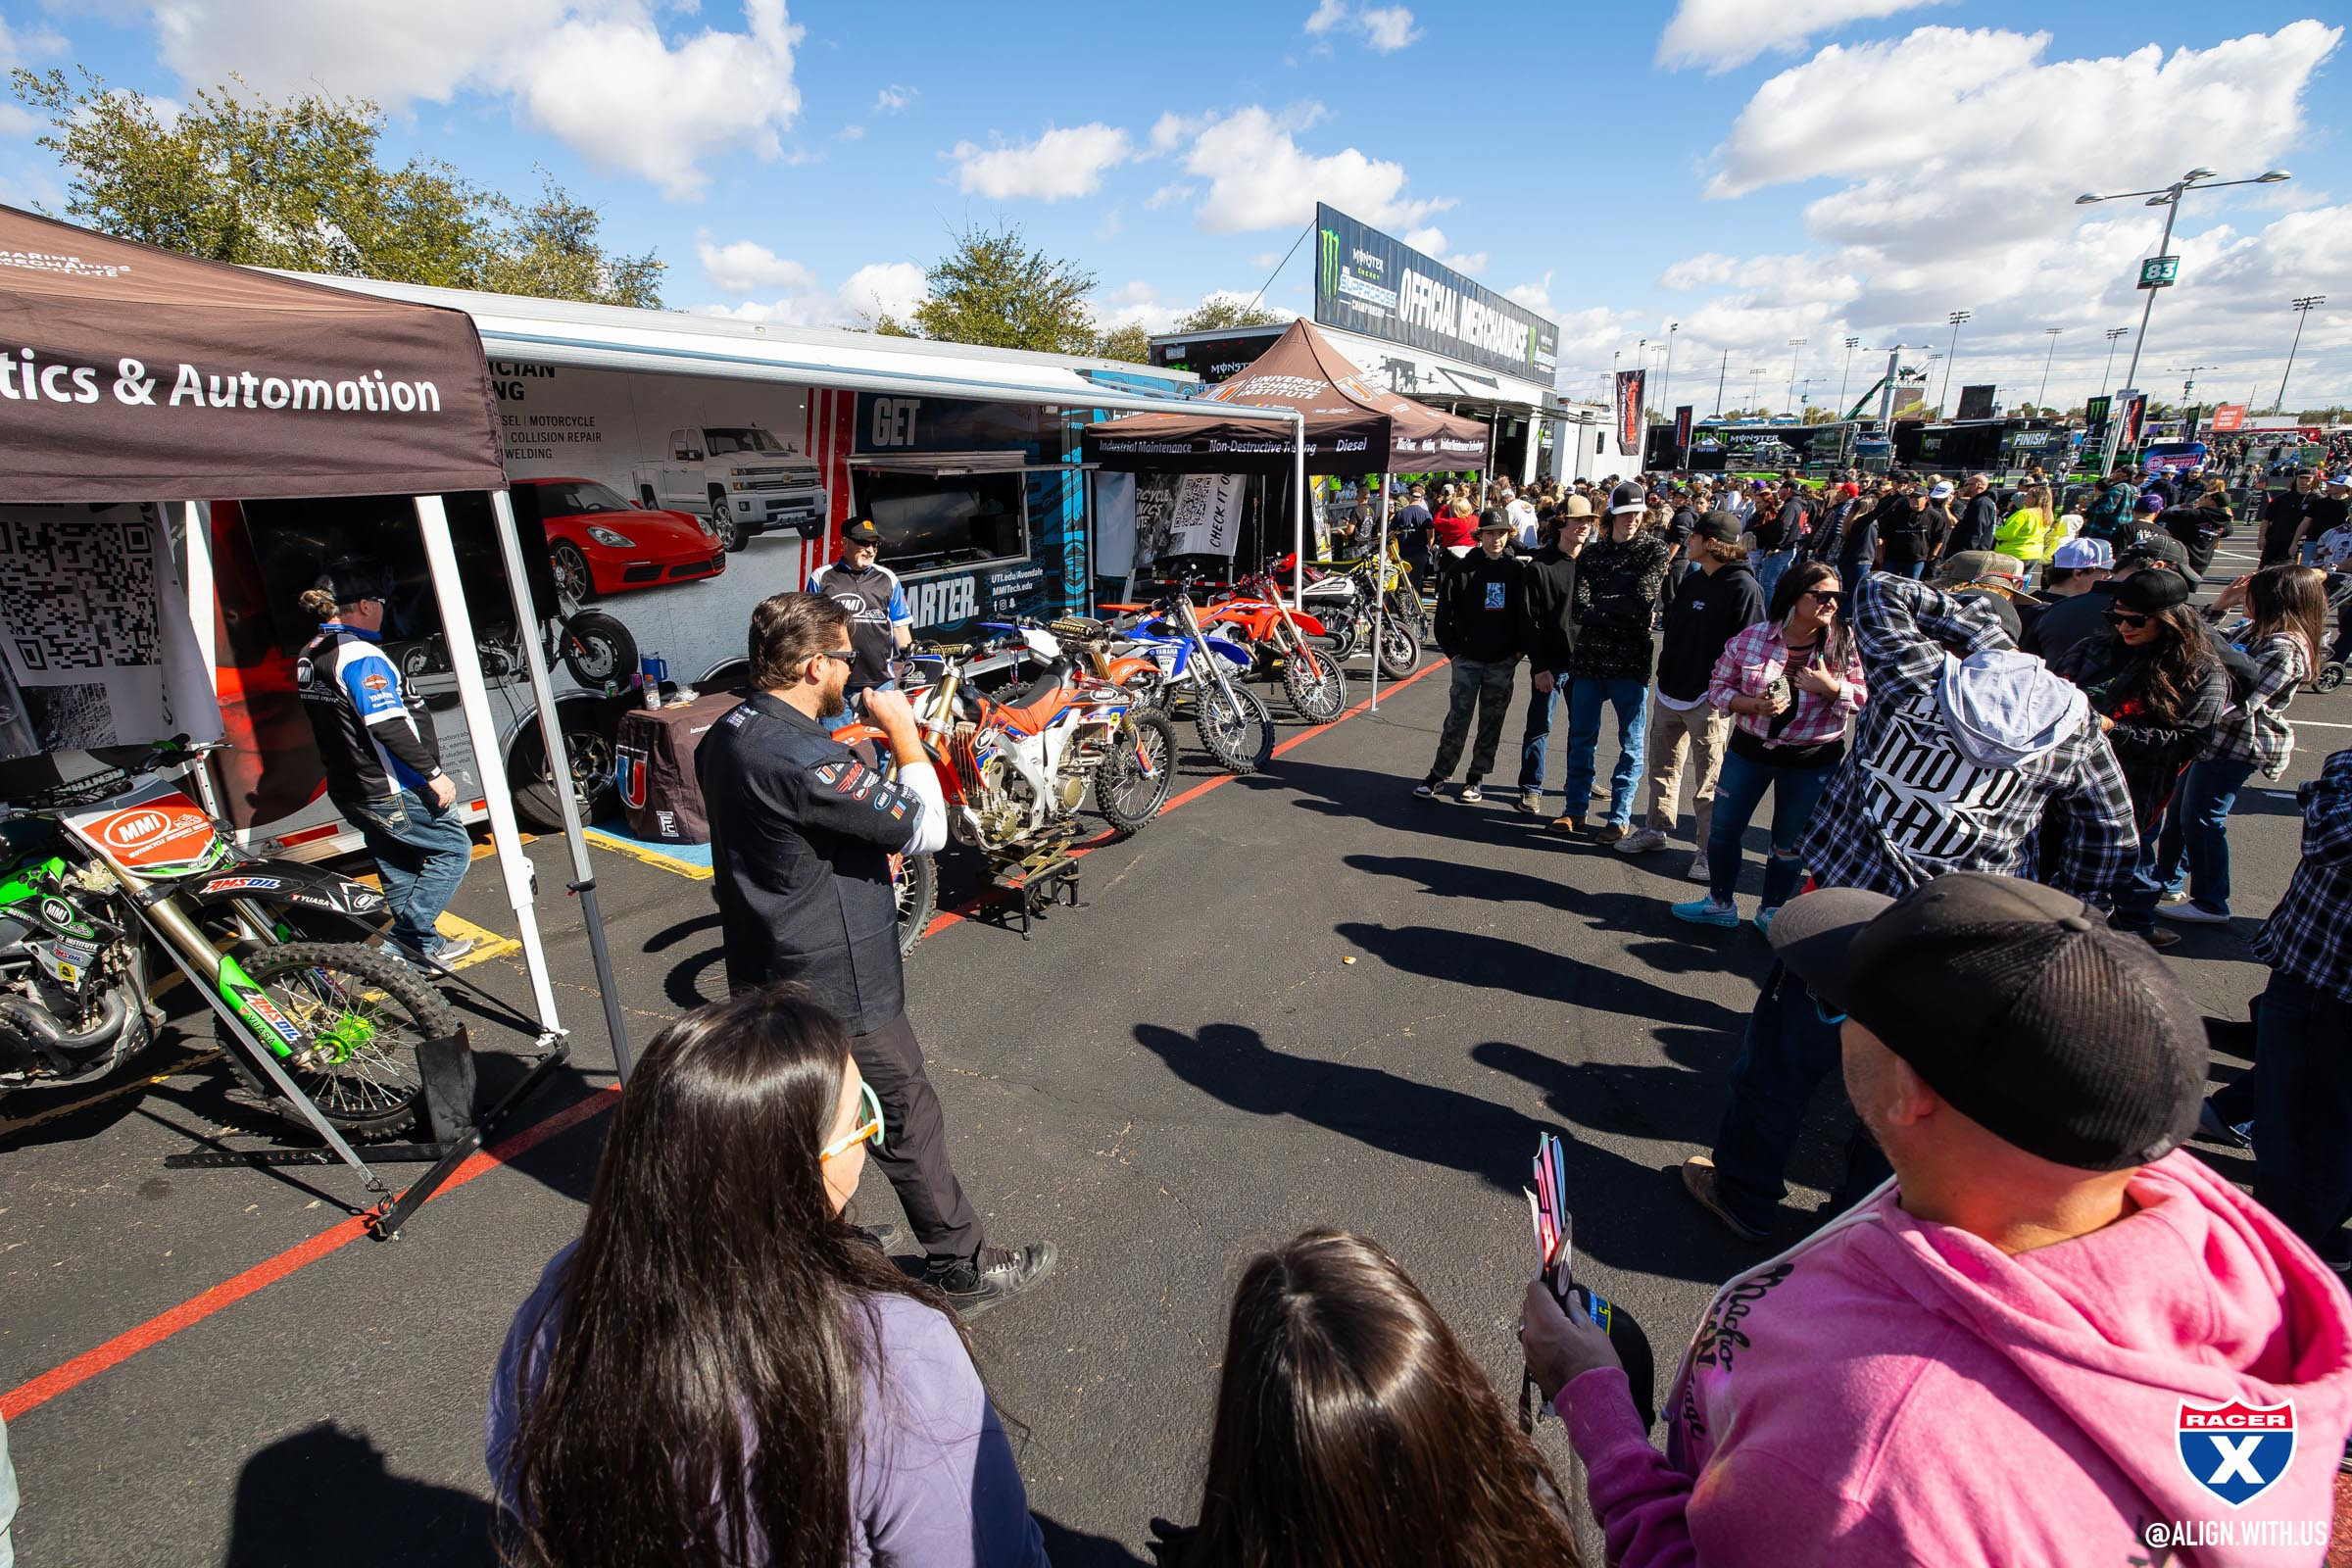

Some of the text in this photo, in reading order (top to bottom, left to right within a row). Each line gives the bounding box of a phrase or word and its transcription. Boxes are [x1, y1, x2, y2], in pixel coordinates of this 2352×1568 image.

[1352, 248, 1384, 273] MONSTER
[2146, 263, 2176, 280] 83
[1399, 268, 1457, 337] OFFICIAL
[1458, 295, 1529, 362] MERCHANDISE
[113, 358, 156, 406] &
[169, 364, 441, 412] Automation
[1245, 383, 1323, 393] TECHNICAL
[1250, 375, 1331, 389] UNIVERSAL
[1238, 390, 1319, 400] INSTITUTE
[529, 416, 596, 427] MOTORCYCLE
[872, 398, 921, 446] GET
[511, 432, 602, 443] COLLISION REPAIR
[1730, 434, 1779, 443] MONSTER
[2014, 432, 2049, 446] FINISH
[1100, 440, 1137, 452] Industrial
[1138, 442, 1193, 454] Maintenance
[1209, 439, 1281, 454] Non-Destructive
[1336, 437, 1367, 452] Diesel
[505, 449, 553, 459] WELDING
[1210, 510, 1224, 548] CHECK
[1219, 489, 1229, 505] IT
[992, 567, 1044, 584] UTI.edu/Avondale
[993, 582, 1033, 597] MMITech.edu
[1051, 621, 1085, 635] RENTHAL
[118, 814, 162, 844] MMI
[128, 838, 166, 859] MOTORCYCLE
[201, 878, 278, 892] AMSOIL
[301, 895, 330, 907] YUASA
[46, 903, 68, 922] MMI
[66, 937, 99, 951] INSTITUTE
[53, 948, 83, 962] AMSOIL
[246, 995, 299, 1041] AMSOIL
[247, 1014, 275, 1045] YUASA
